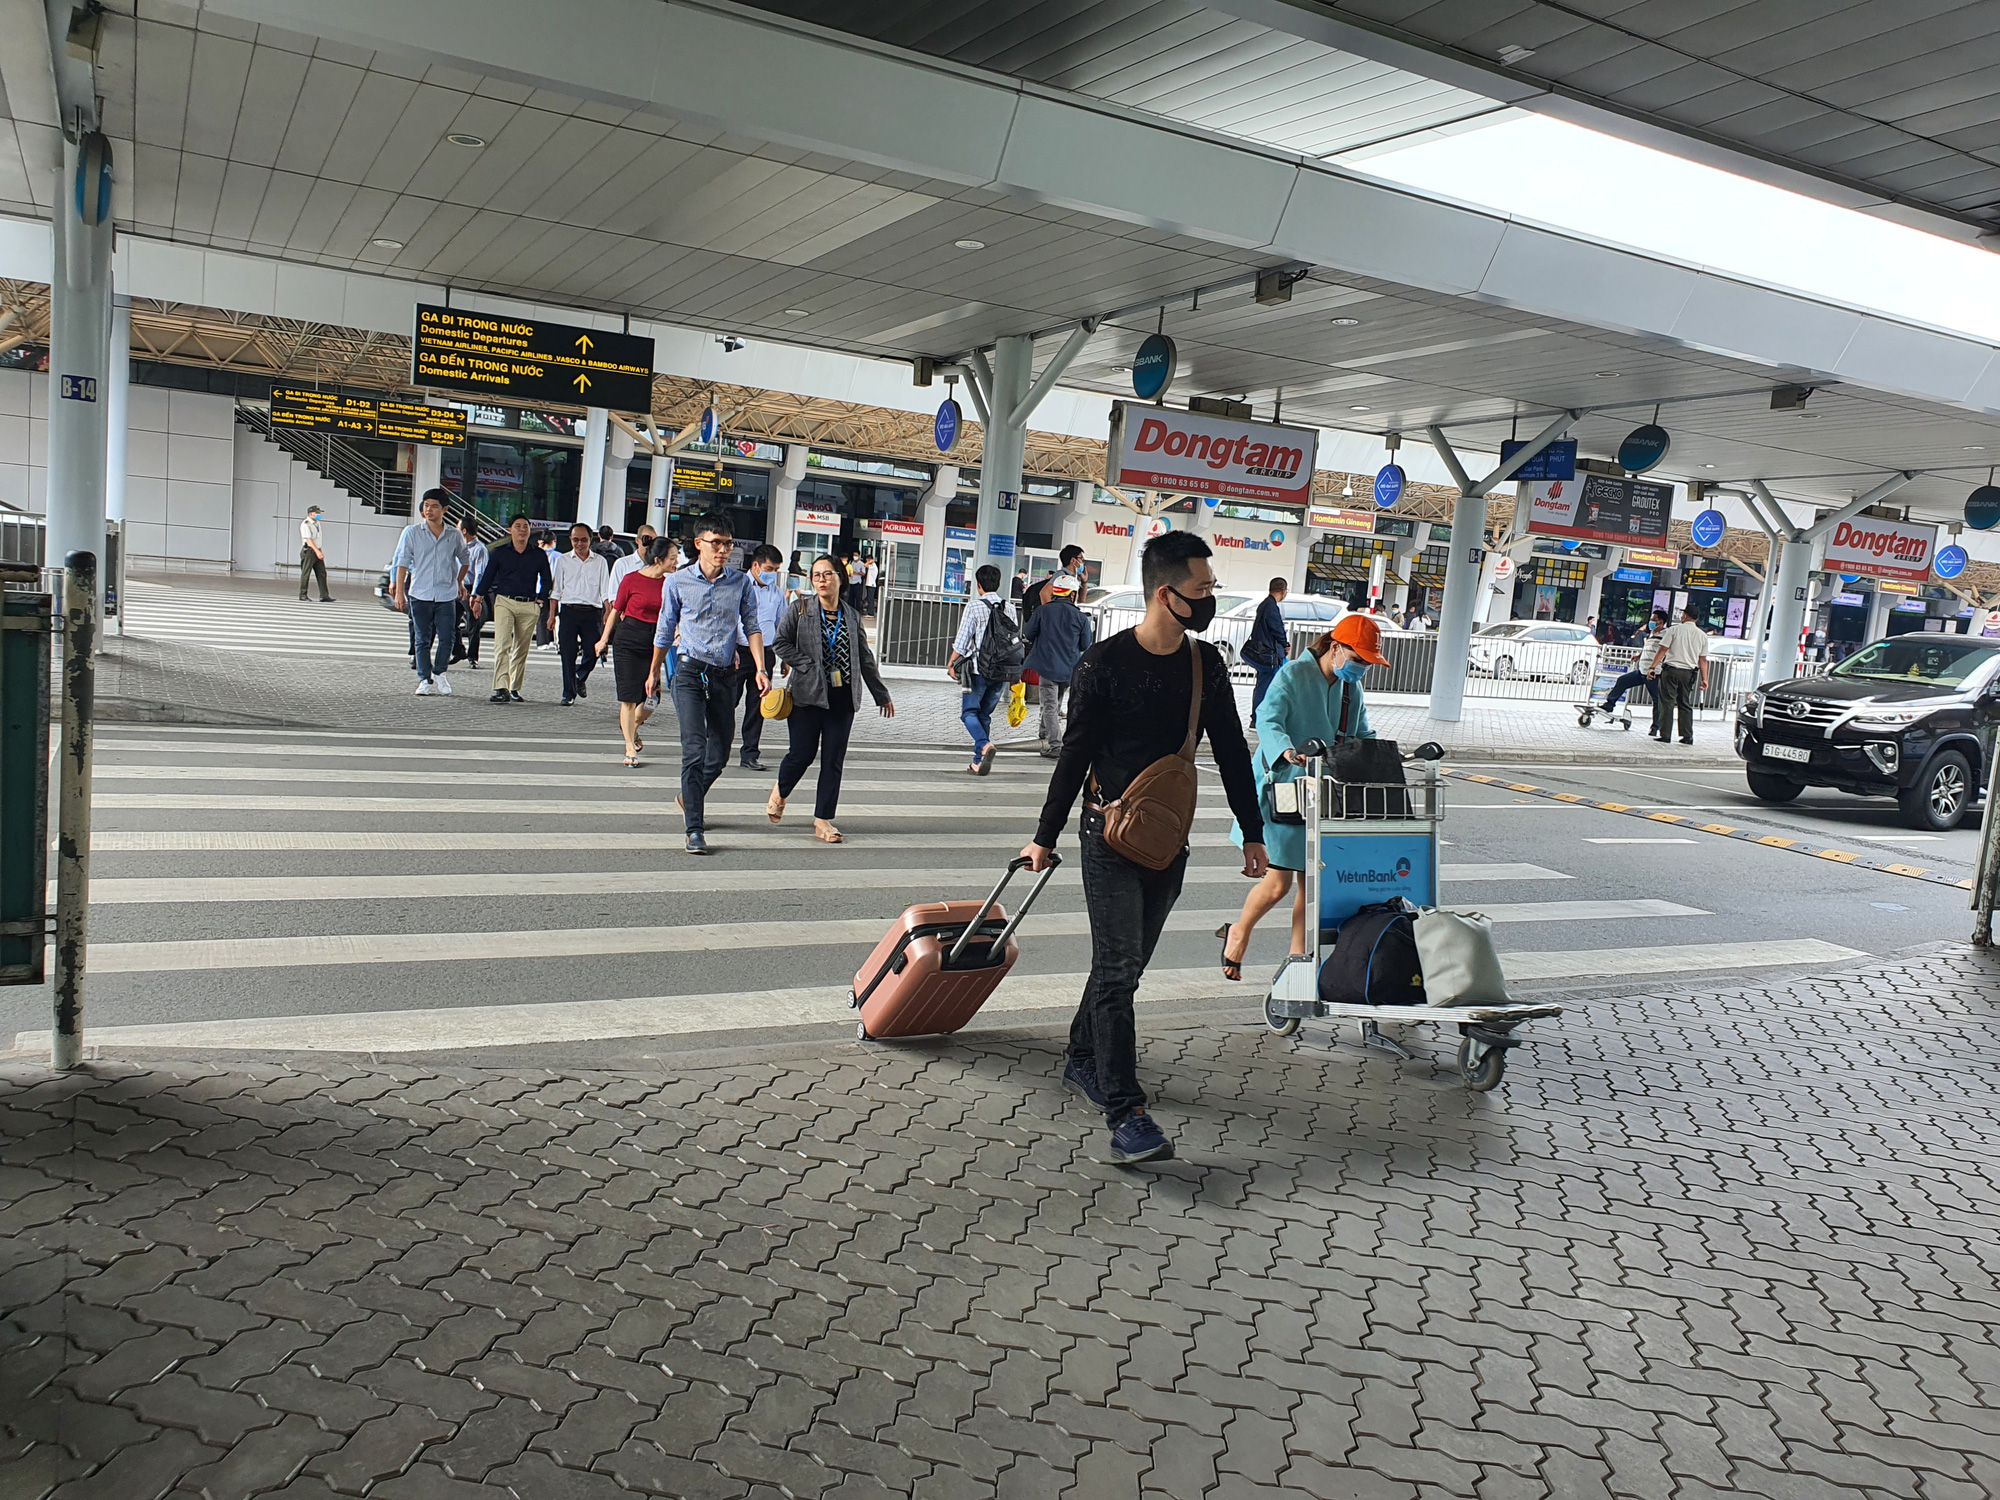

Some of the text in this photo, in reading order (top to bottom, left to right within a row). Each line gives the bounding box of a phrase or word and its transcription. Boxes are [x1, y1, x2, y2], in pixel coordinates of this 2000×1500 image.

[421, 311, 534, 336] GA ĐI TRONG NƯỚC
[420, 324, 528, 348] Domestic Departures
[420, 337, 453, 347] VIETNAM
[491, 346, 519, 357] PACIFIC
[520, 350, 552, 361] AIRLINES
[588, 360, 617, 370] BAMBOO
[618, 364, 649, 375] AIRWAYS
[419, 352, 544, 377] GA ĐẾN TRONG NƯỚC
[419, 364, 510, 385] Domestic Arrivals
[62, 377, 96, 400] B-14
[346, 399, 370, 408] D1-D2
[431, 410, 454, 418] D3-D4
[338, 421, 361, 430] A1-A3
[1134, 418, 1303, 471] Dongtam
[1251, 468, 1291, 478] GROUP
[721, 478, 732, 486] D3
[1159, 476, 1209, 489] 1900 63 65 65
[1226, 485, 1279, 498] dongtam.com.vn
[1000, 492, 1017, 509] B-13
[1534, 498, 1570, 511] Dongtam
[884, 524, 921, 533] AGRIBANK
[1314, 514, 1345, 524] Homtamin
[1346, 518, 1371, 528] Ginseng
[1213, 534, 1270, 550] VietinBank
[1833, 522, 1928, 557] Dongtam
[1765, 745, 1808, 761] 51G-445.80
[1336, 869, 1396, 883] VietinBank
